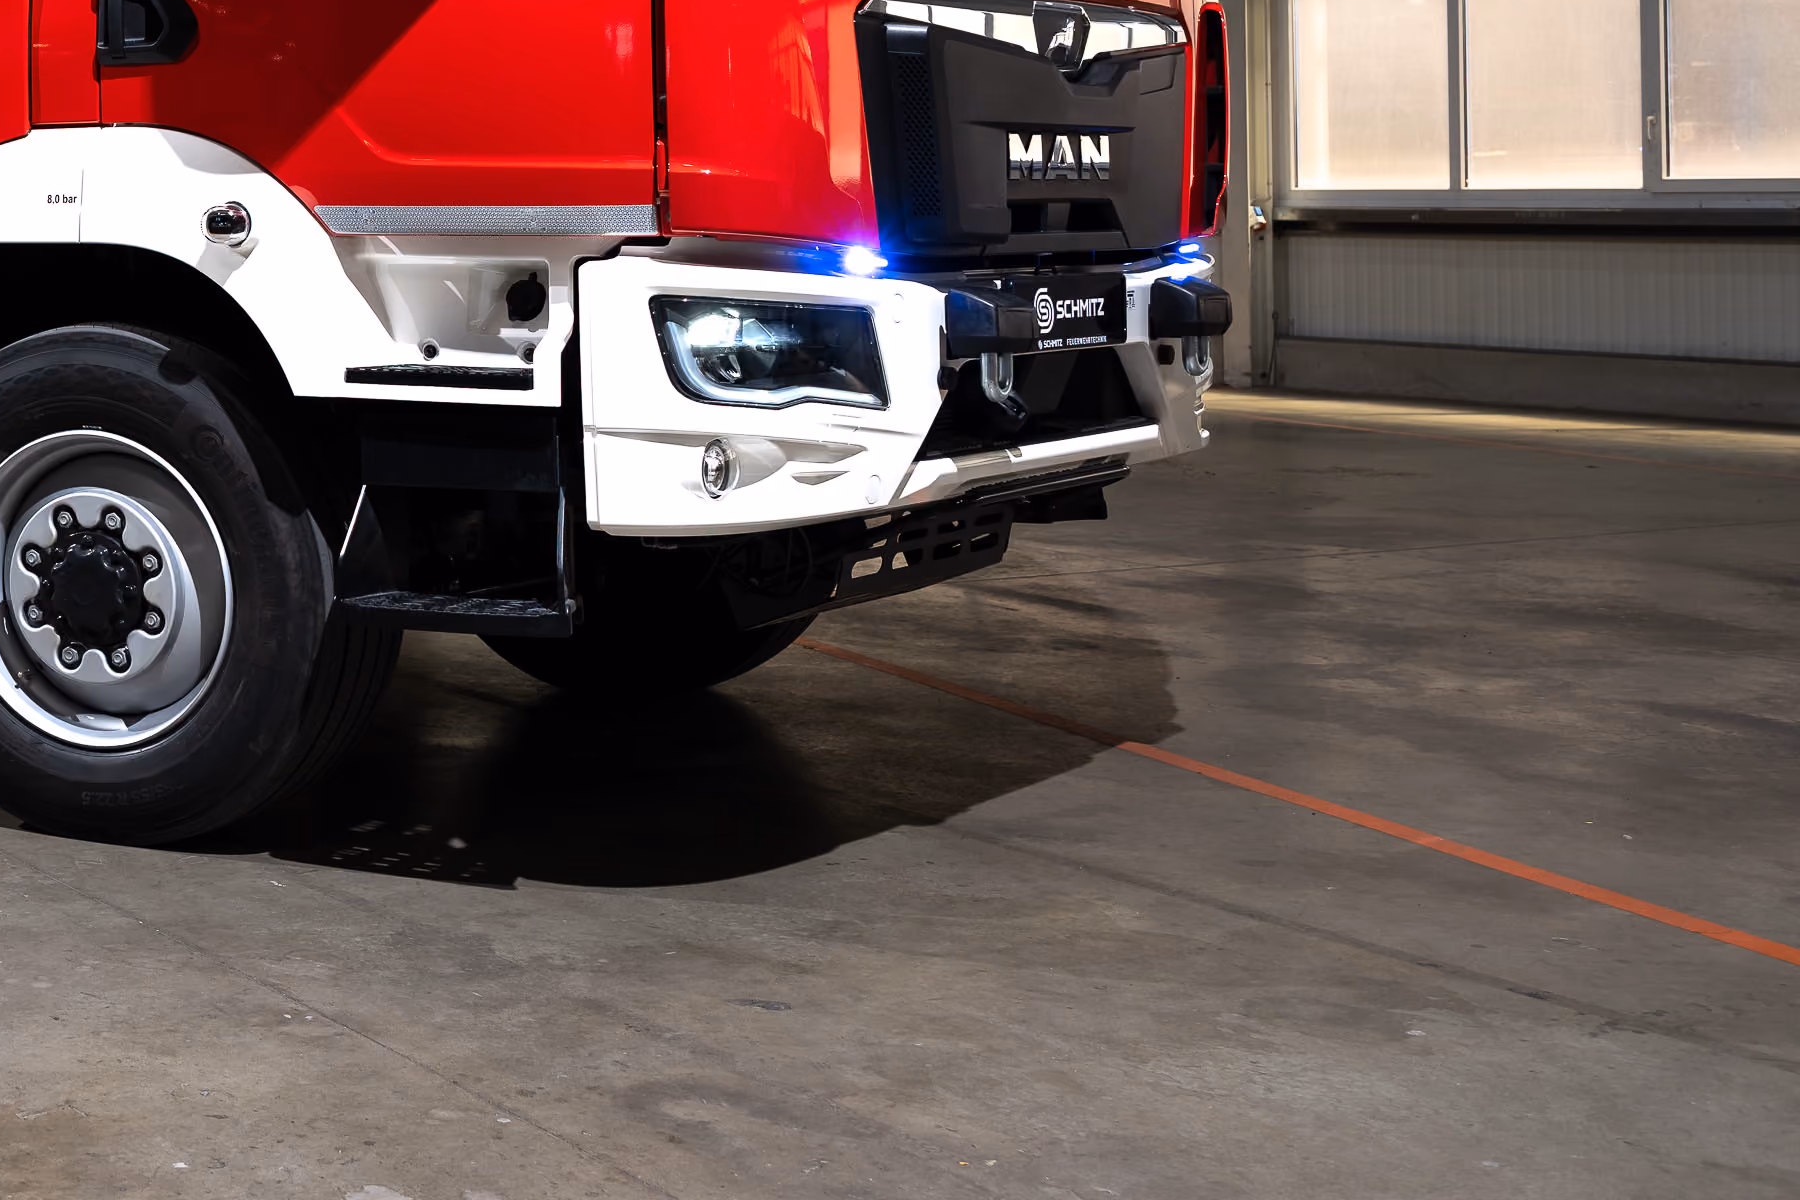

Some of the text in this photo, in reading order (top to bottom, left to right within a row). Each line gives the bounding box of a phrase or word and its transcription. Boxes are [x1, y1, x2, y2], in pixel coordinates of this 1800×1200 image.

[1008, 133, 1110, 180] MAN
[47, 194, 77, 204] 8.0 bar
[1056, 298, 1105, 319] SCHMITZ
[1043, 339, 1063, 349] SCHMITZ
